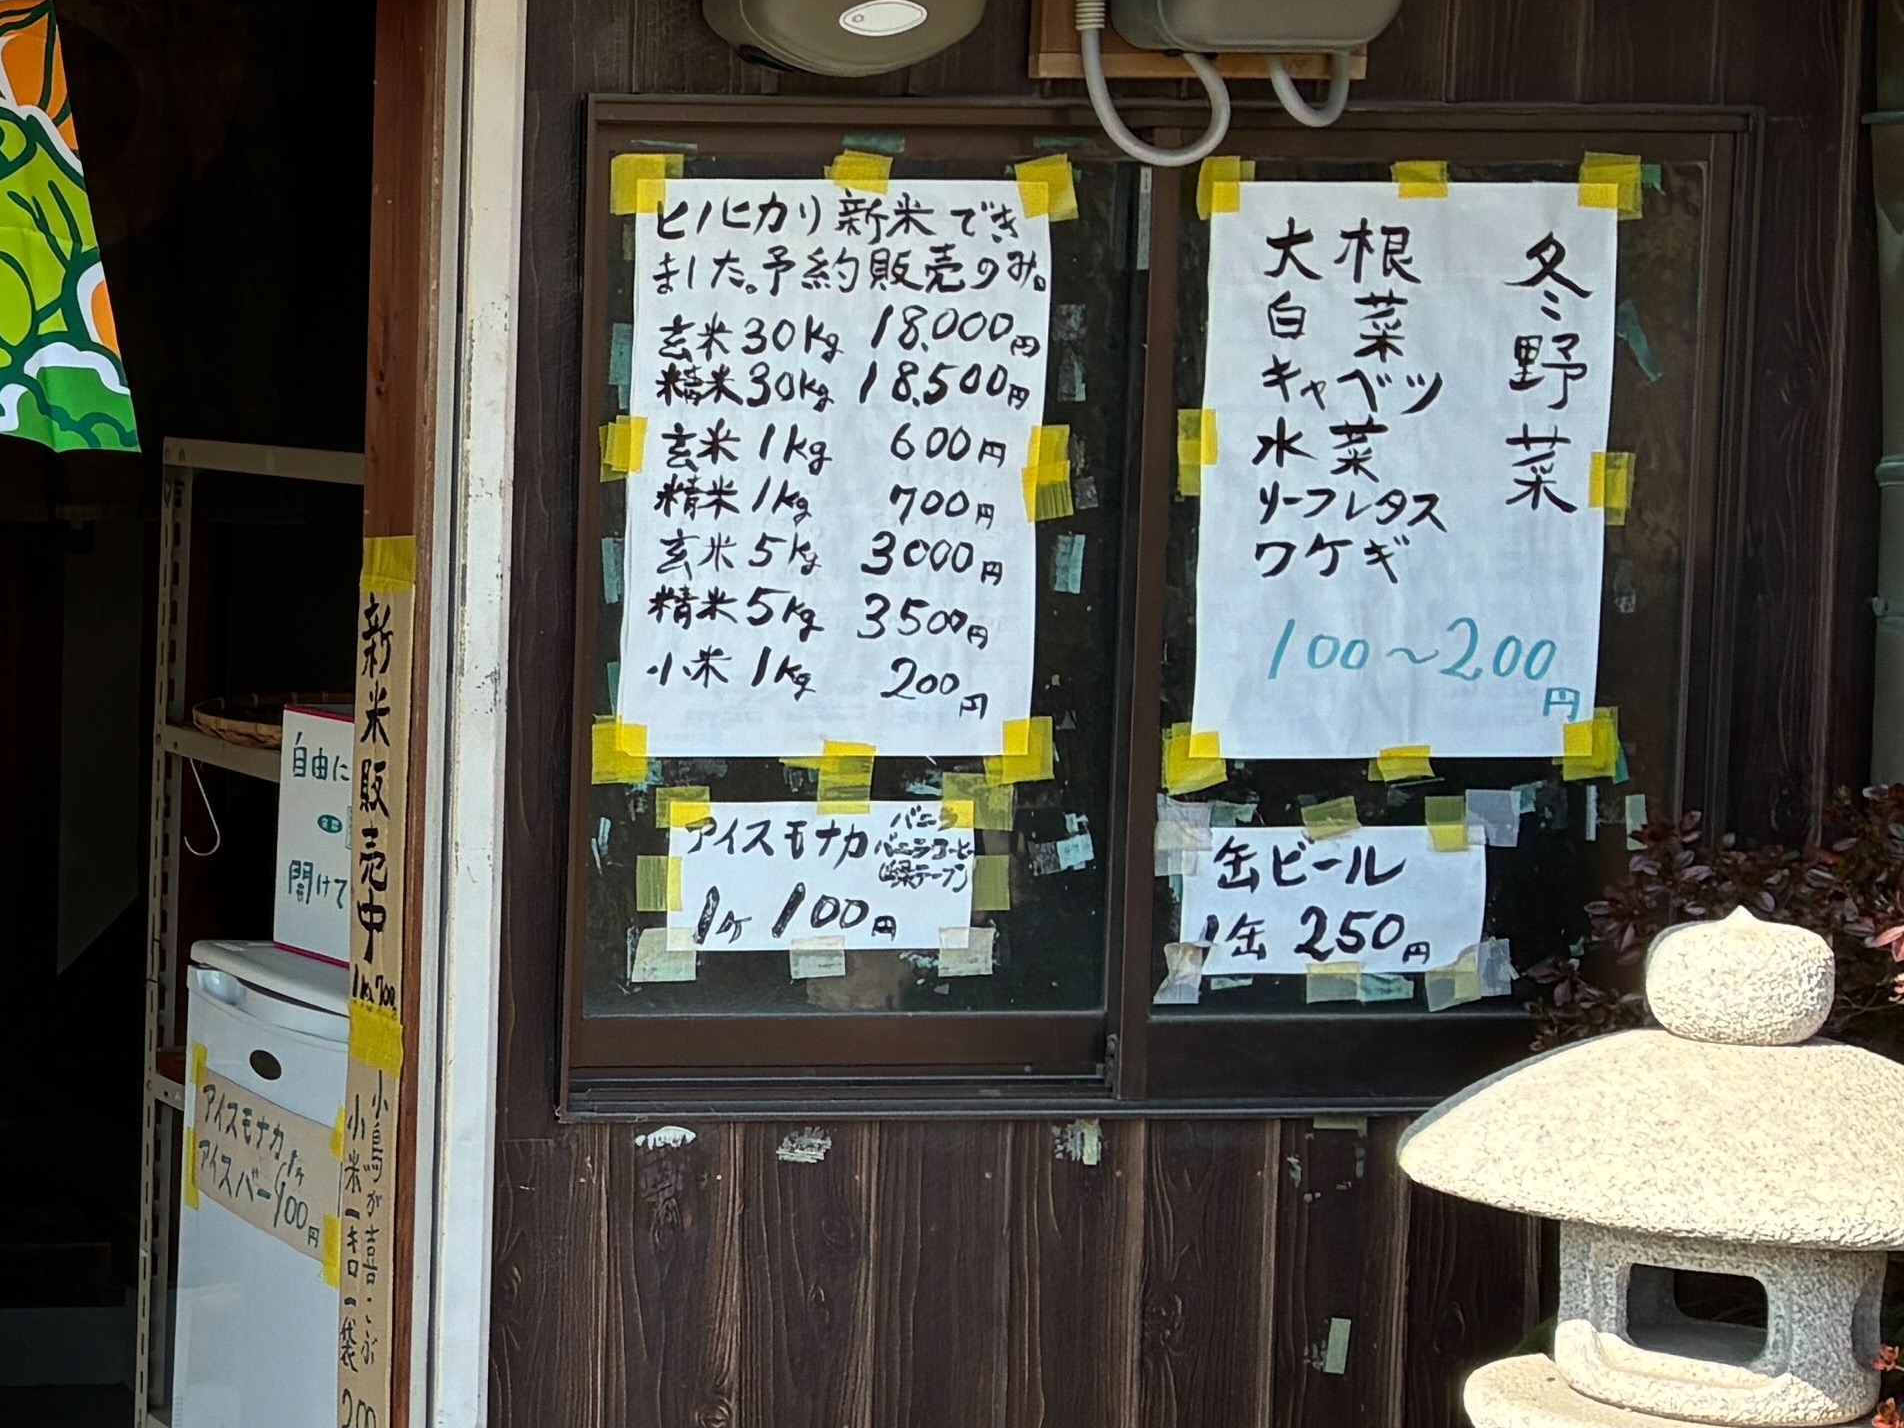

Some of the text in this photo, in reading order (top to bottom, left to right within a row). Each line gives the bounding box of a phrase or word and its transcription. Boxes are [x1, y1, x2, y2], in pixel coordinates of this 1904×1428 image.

[656, 187, 1021, 245] ヒノヒカリ新米でき
[1265, 215, 1422, 285] 大根
[1265, 289, 1409, 363] 白菜
[1261, 353, 1445, 415] キャベツ
[1503, 230, 1595, 515] 冬野菜
[890, 423, 1007, 469] 600円
[1250, 413, 1390, 483] 水菜
[890, 485, 996, 529] 700円
[1257, 483, 1449, 534] リーフレタス
[860, 530, 1004, 585] 3000円
[1253, 532, 1413, 584] ワケギ
[857, 591, 989, 650] 3500円
[879, 656, 989, 720] 200円
[292, 731, 351, 782] 自由に
[357, 591, 395, 963] 新米販売中
[685, 816, 869, 869] アイスモナカ
[1213, 834, 1407, 894] 缶ビール
[288, 859, 349, 910] 開けて
[202, 1083, 285, 1161] アイスモナカ
